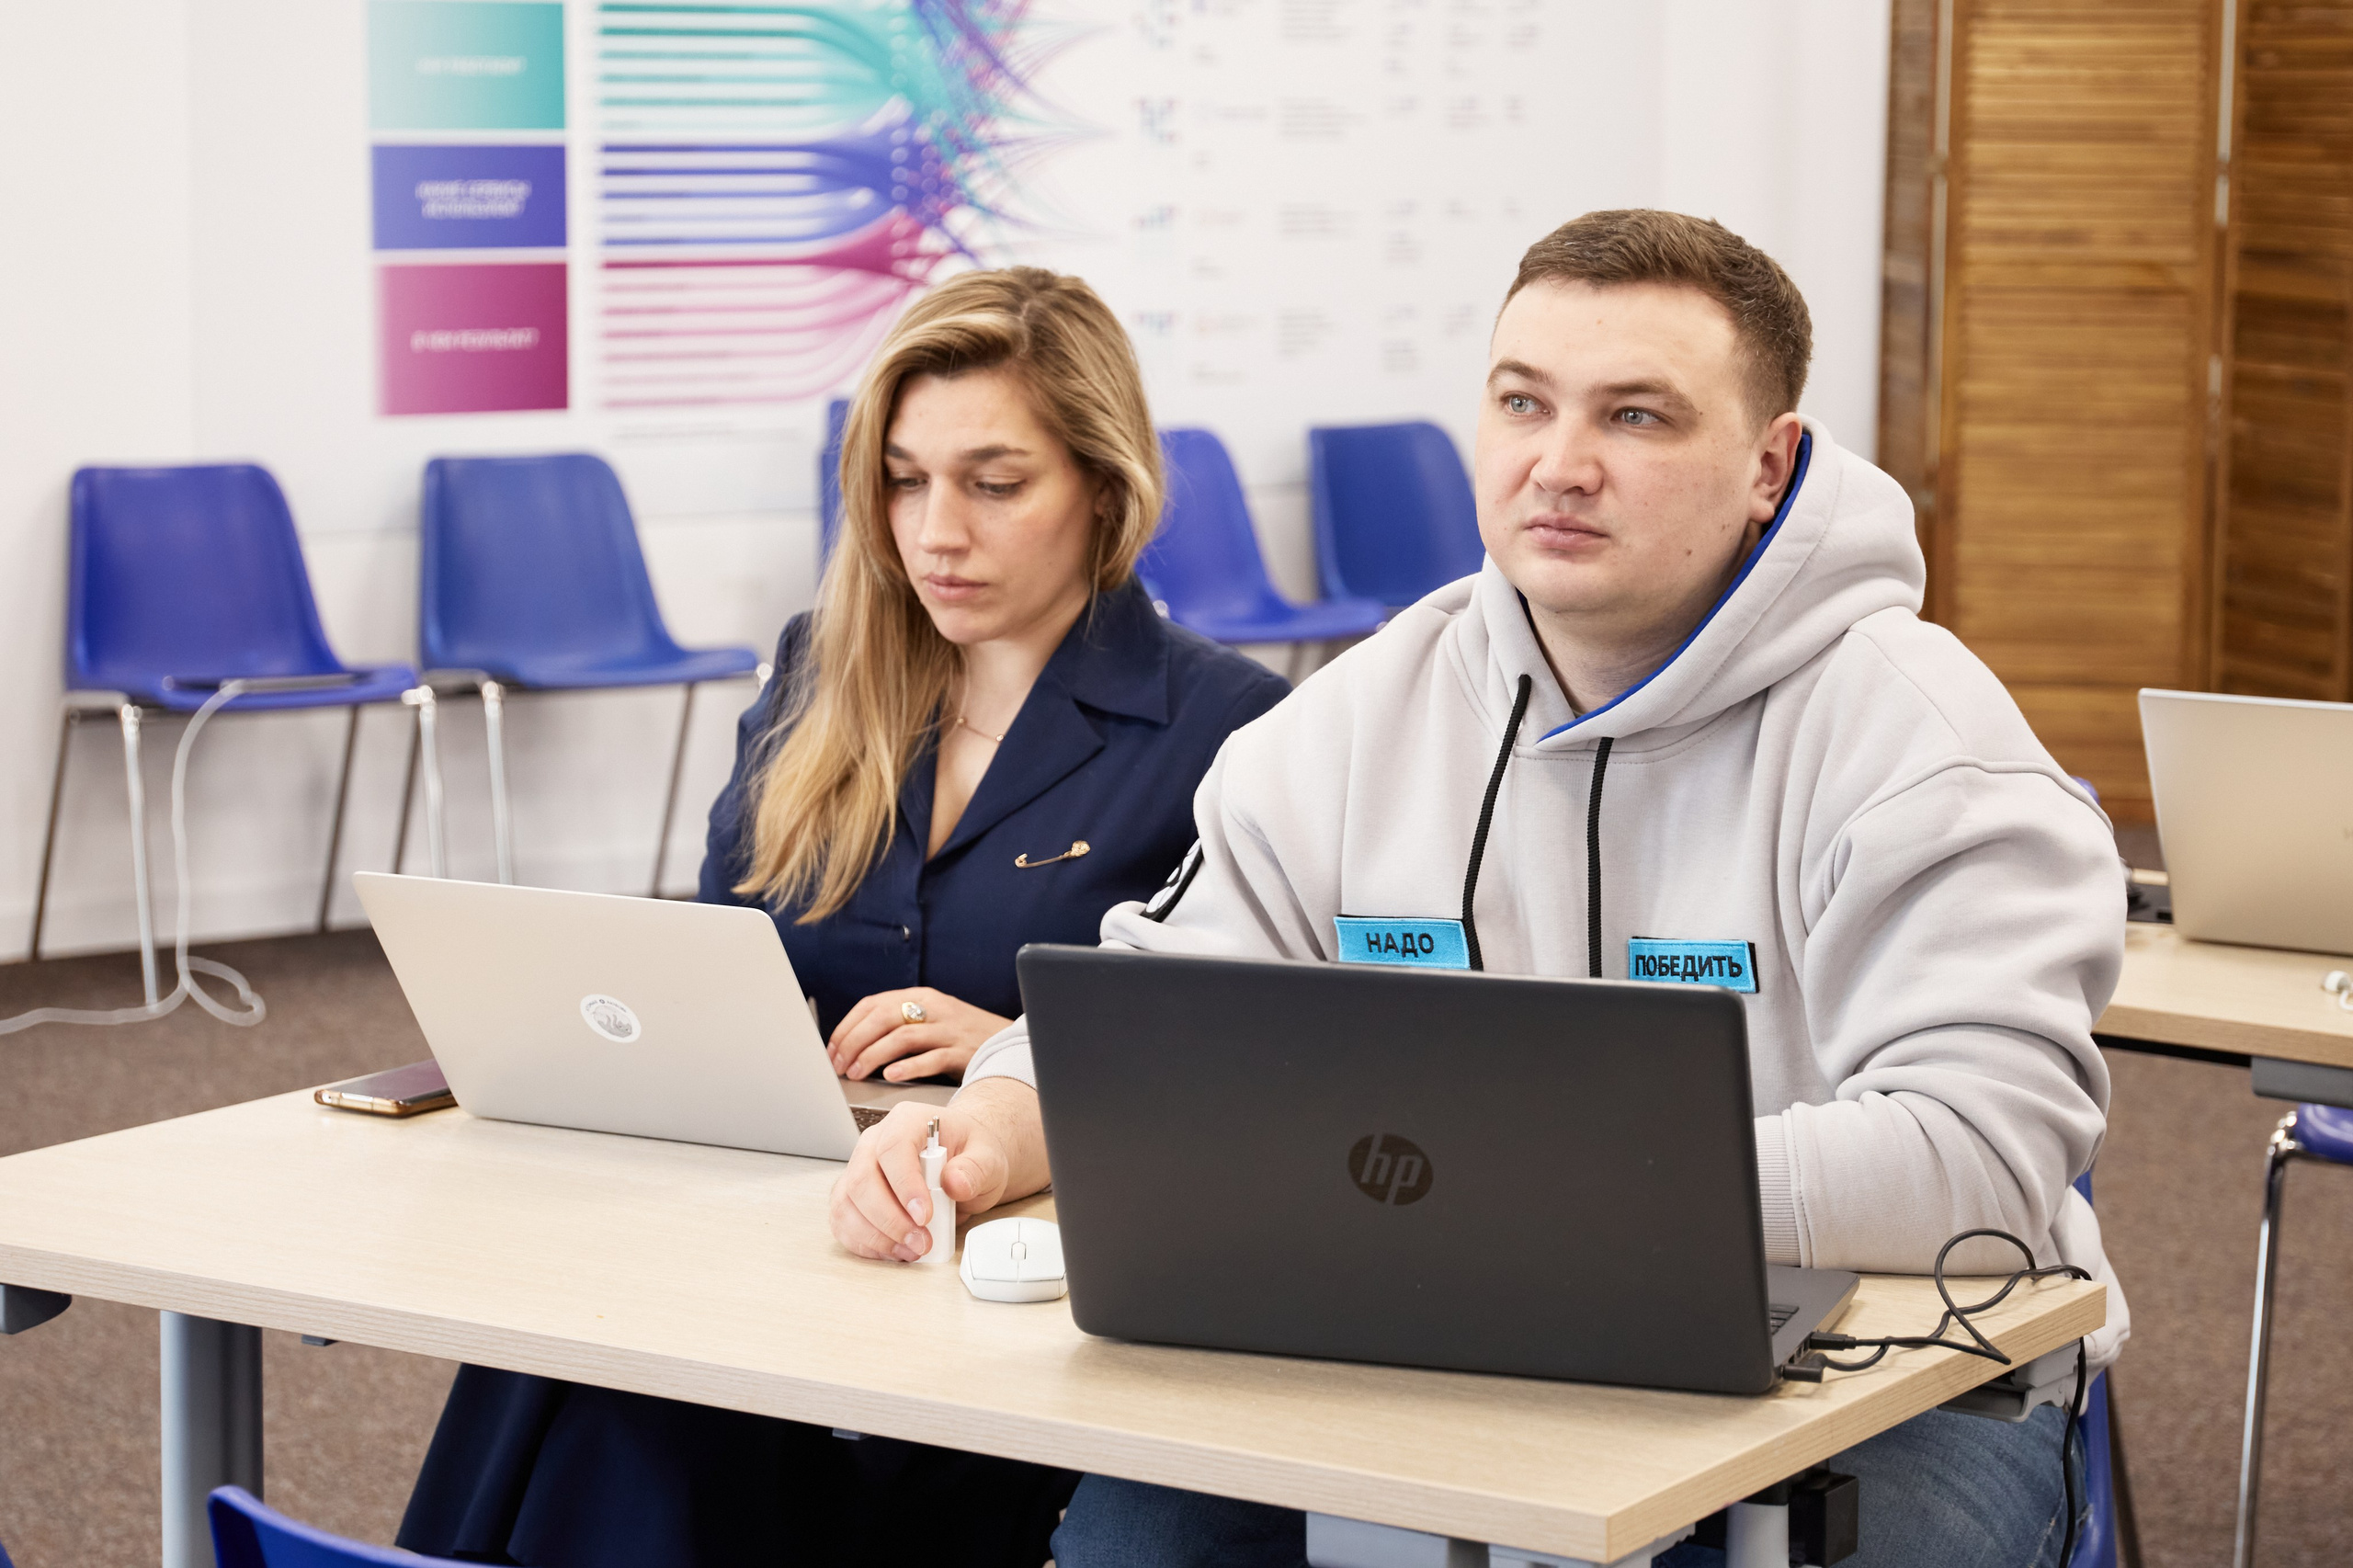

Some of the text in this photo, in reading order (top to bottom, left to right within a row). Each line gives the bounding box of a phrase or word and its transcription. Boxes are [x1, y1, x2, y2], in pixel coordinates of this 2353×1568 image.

[1366, 932, 1435, 958] НАДО
[1635, 954, 1743, 982] ПОБЕДИТЬ
[1359, 1133, 1425, 1205] hp
